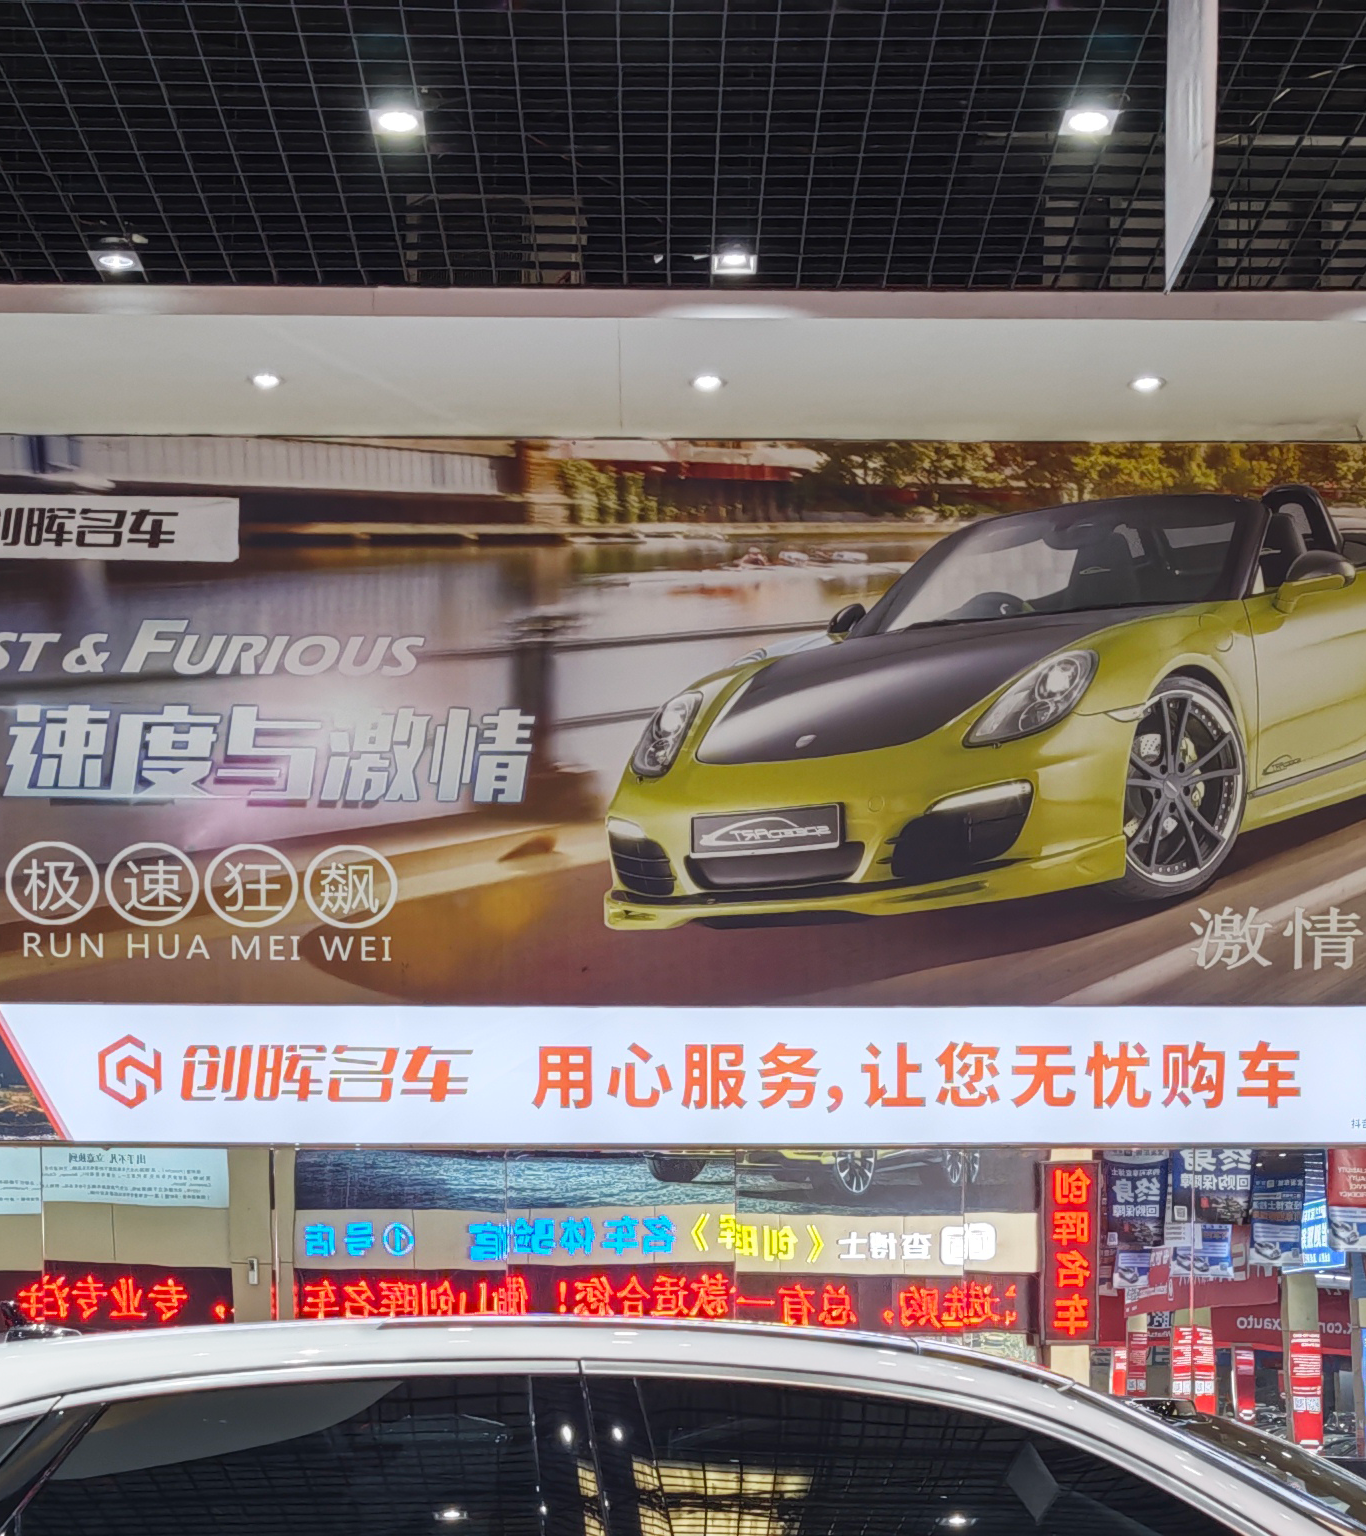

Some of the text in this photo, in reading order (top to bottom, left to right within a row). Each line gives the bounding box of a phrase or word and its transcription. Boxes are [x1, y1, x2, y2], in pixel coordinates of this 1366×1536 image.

[62, 632, 110, 674] &
[120, 619, 426, 677] FURIOUS
[1, 703, 536, 806] 速度与激情
[22, 856, 380, 915] 极速狂飙
[22, 931, 393, 962] RUN HUA MEI WEI
[180, 1041, 1303, 1110] 创晖名车 用心服务，让您无忧购车
